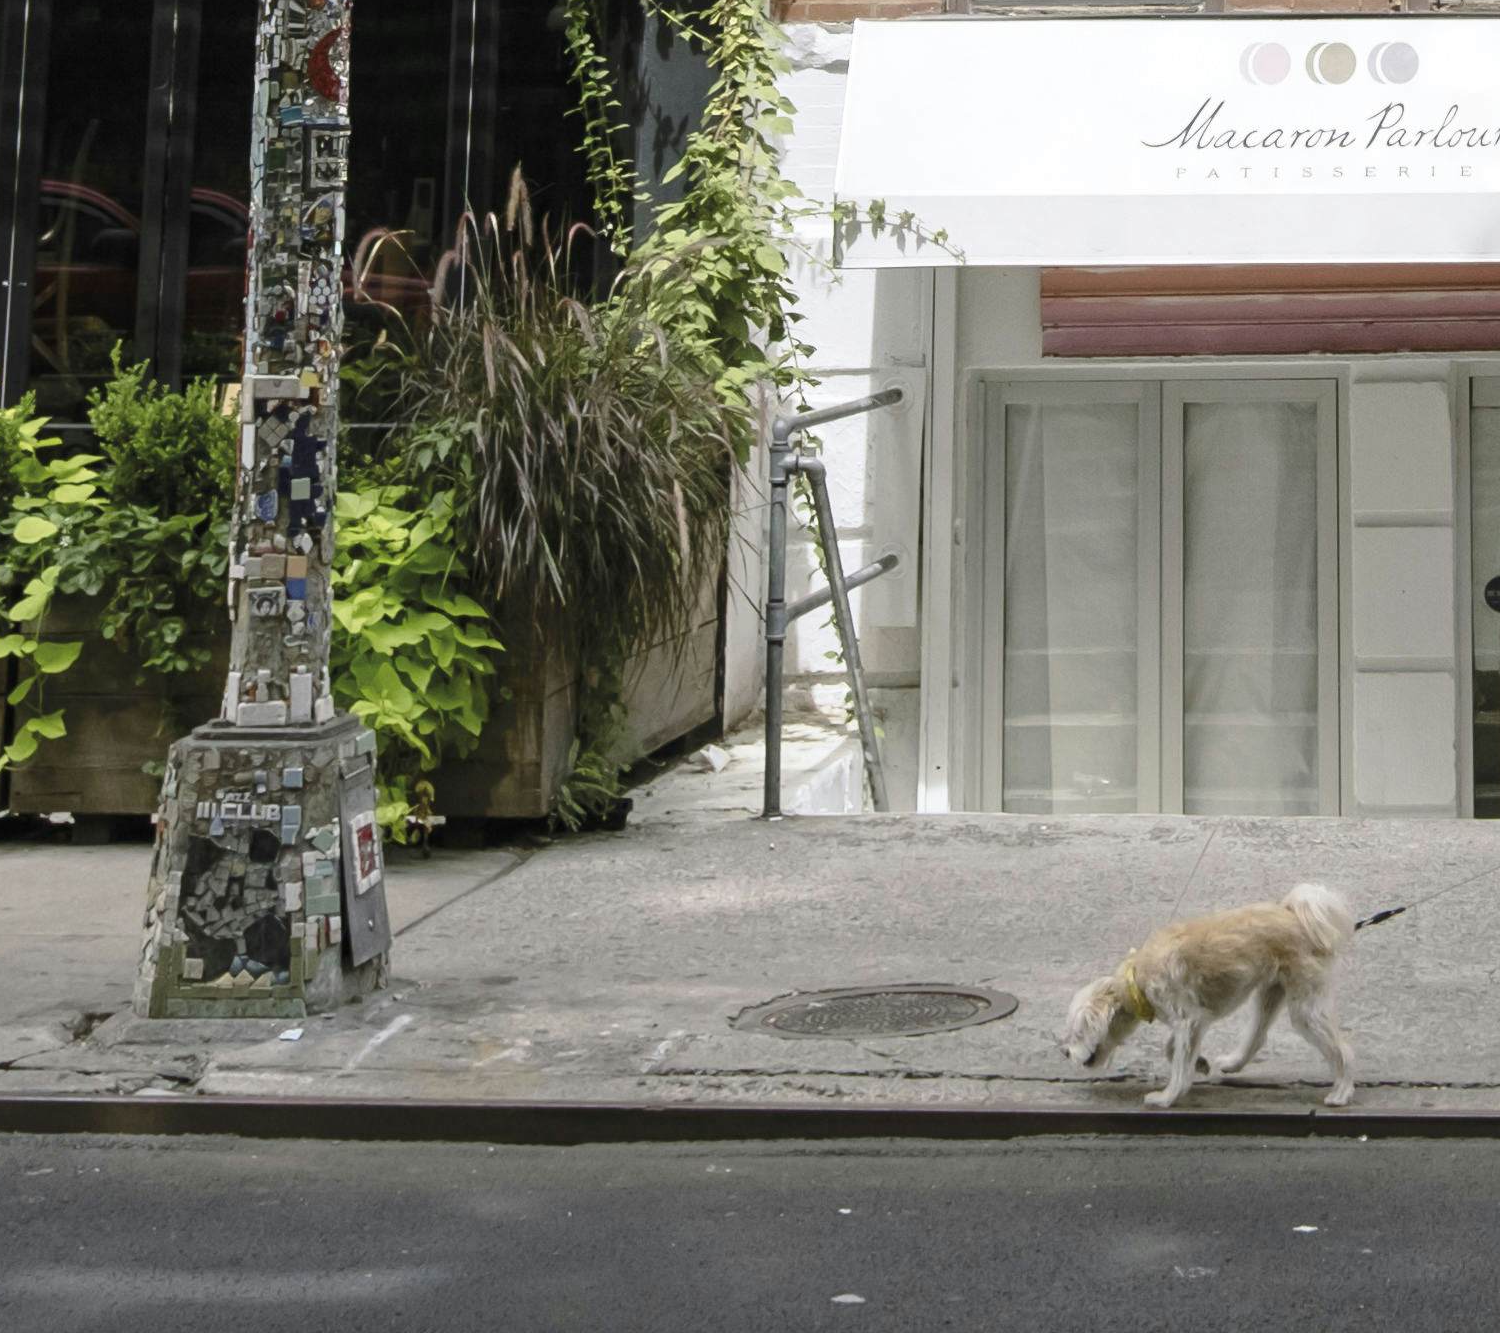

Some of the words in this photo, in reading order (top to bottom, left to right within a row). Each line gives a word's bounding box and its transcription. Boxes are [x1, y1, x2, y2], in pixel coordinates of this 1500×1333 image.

[1140, 97, 1357, 149] Macaron
[1176, 165, 1474, 179] PATISSERIE
[220, 803, 281, 821] CLUB
